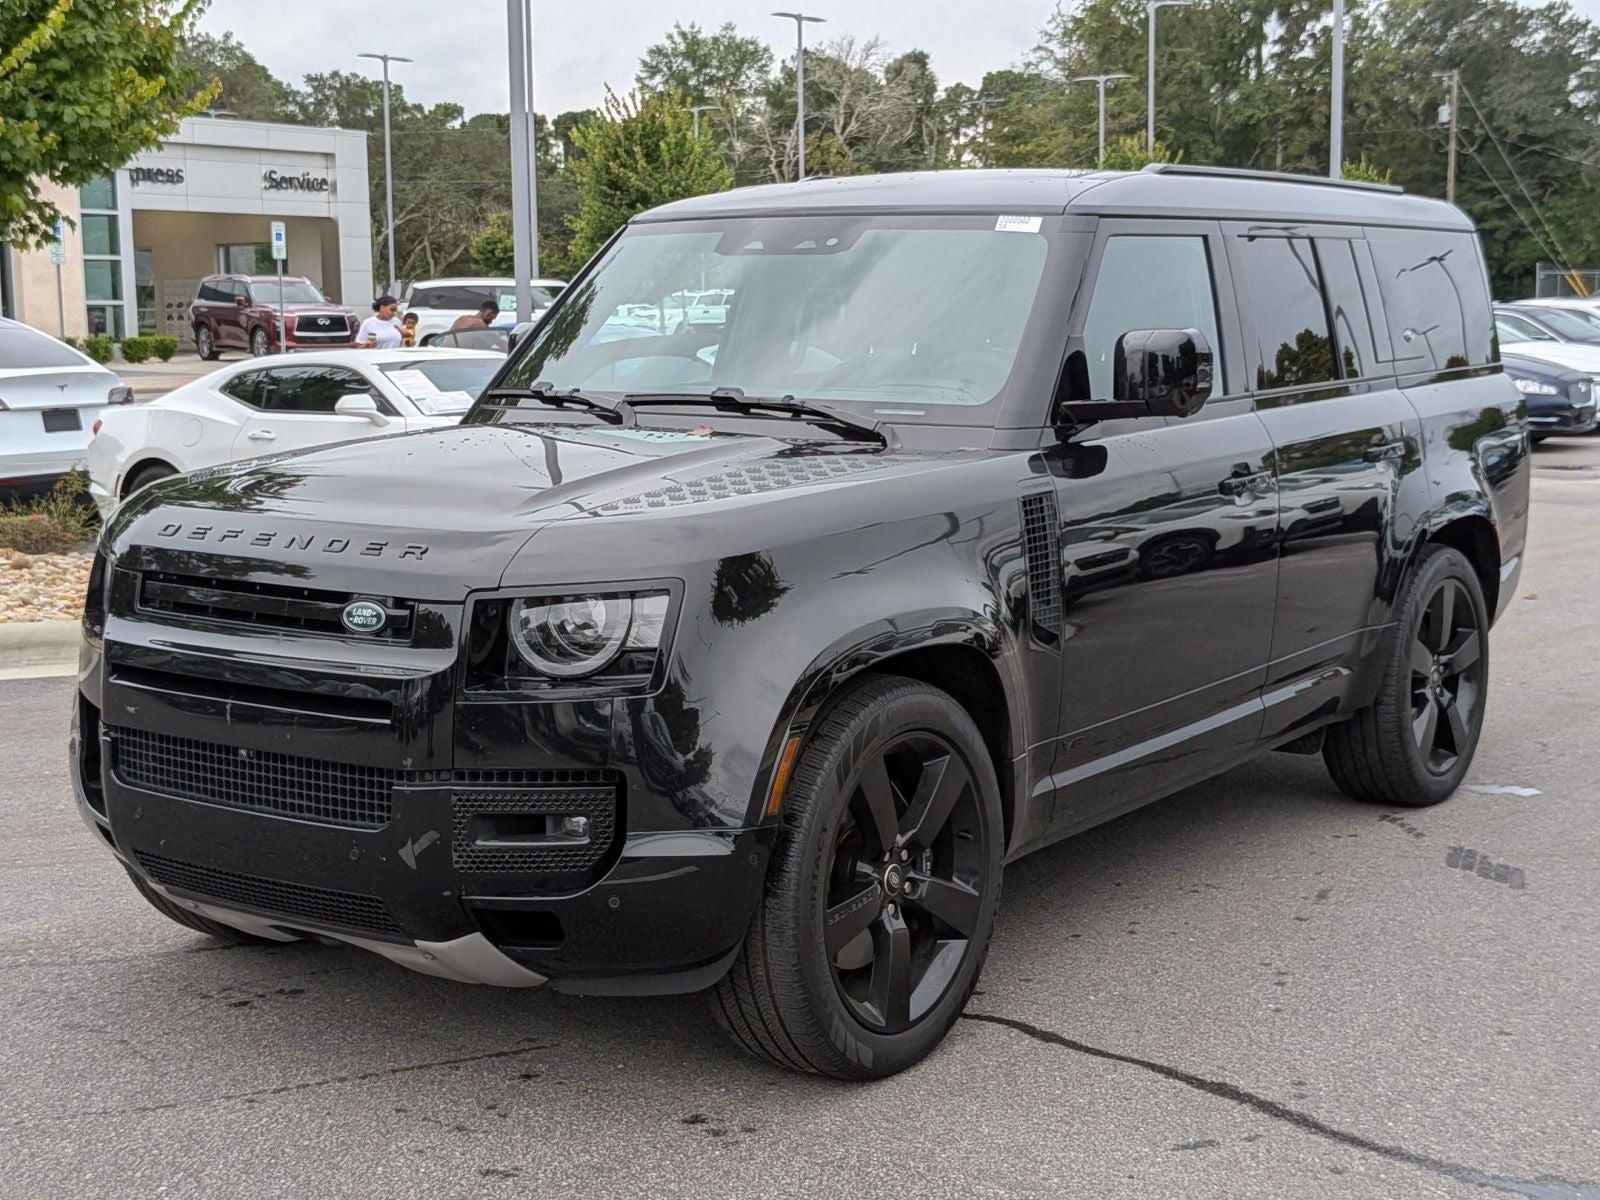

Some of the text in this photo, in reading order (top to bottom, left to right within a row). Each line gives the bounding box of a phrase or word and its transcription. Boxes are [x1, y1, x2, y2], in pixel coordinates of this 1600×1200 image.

[263, 170, 329, 192] Service
[157, 523, 430, 561] DEFENDER
[352, 607, 373, 617] LAND
[352, 616, 378, 625] ROVER
